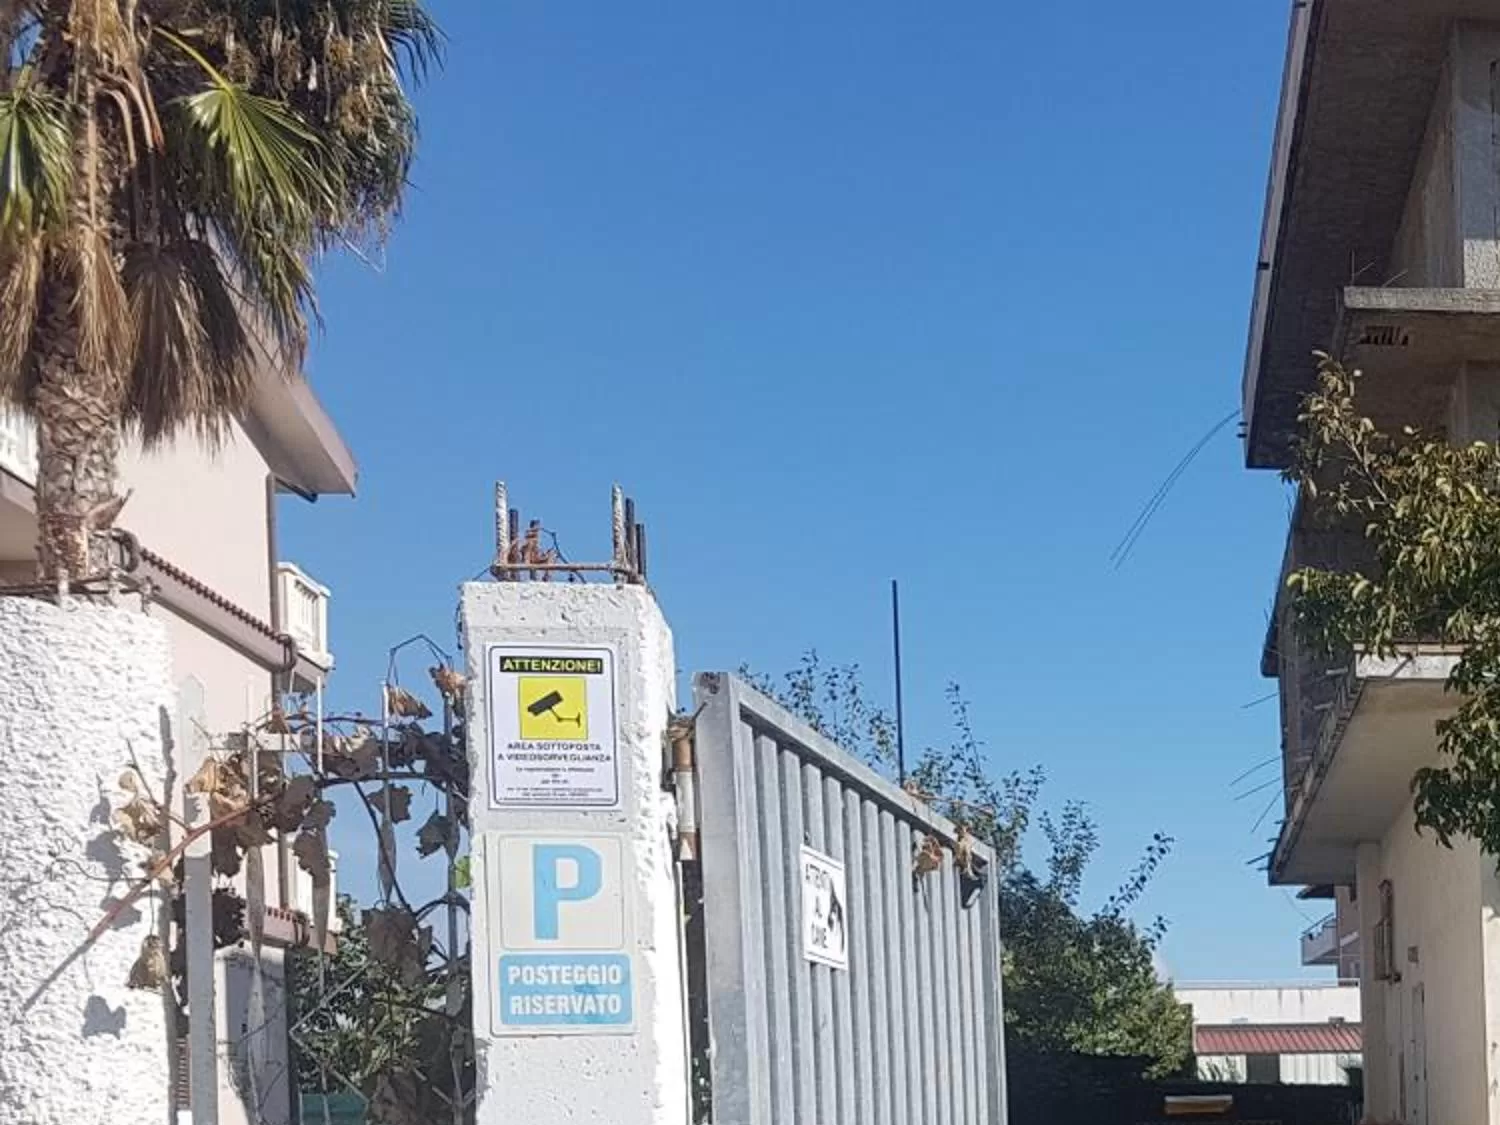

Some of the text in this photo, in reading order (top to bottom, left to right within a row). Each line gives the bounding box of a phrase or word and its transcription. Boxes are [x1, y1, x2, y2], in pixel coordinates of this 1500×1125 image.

[503, 658, 601, 672] ATTENZIONE!
[507, 742, 601, 751] AREA SOTTOPOSTA
[534, 844, 603, 940] P
[508, 964, 622, 985] POSTEGGIO
[511, 995, 621, 1015] RISERVATO
